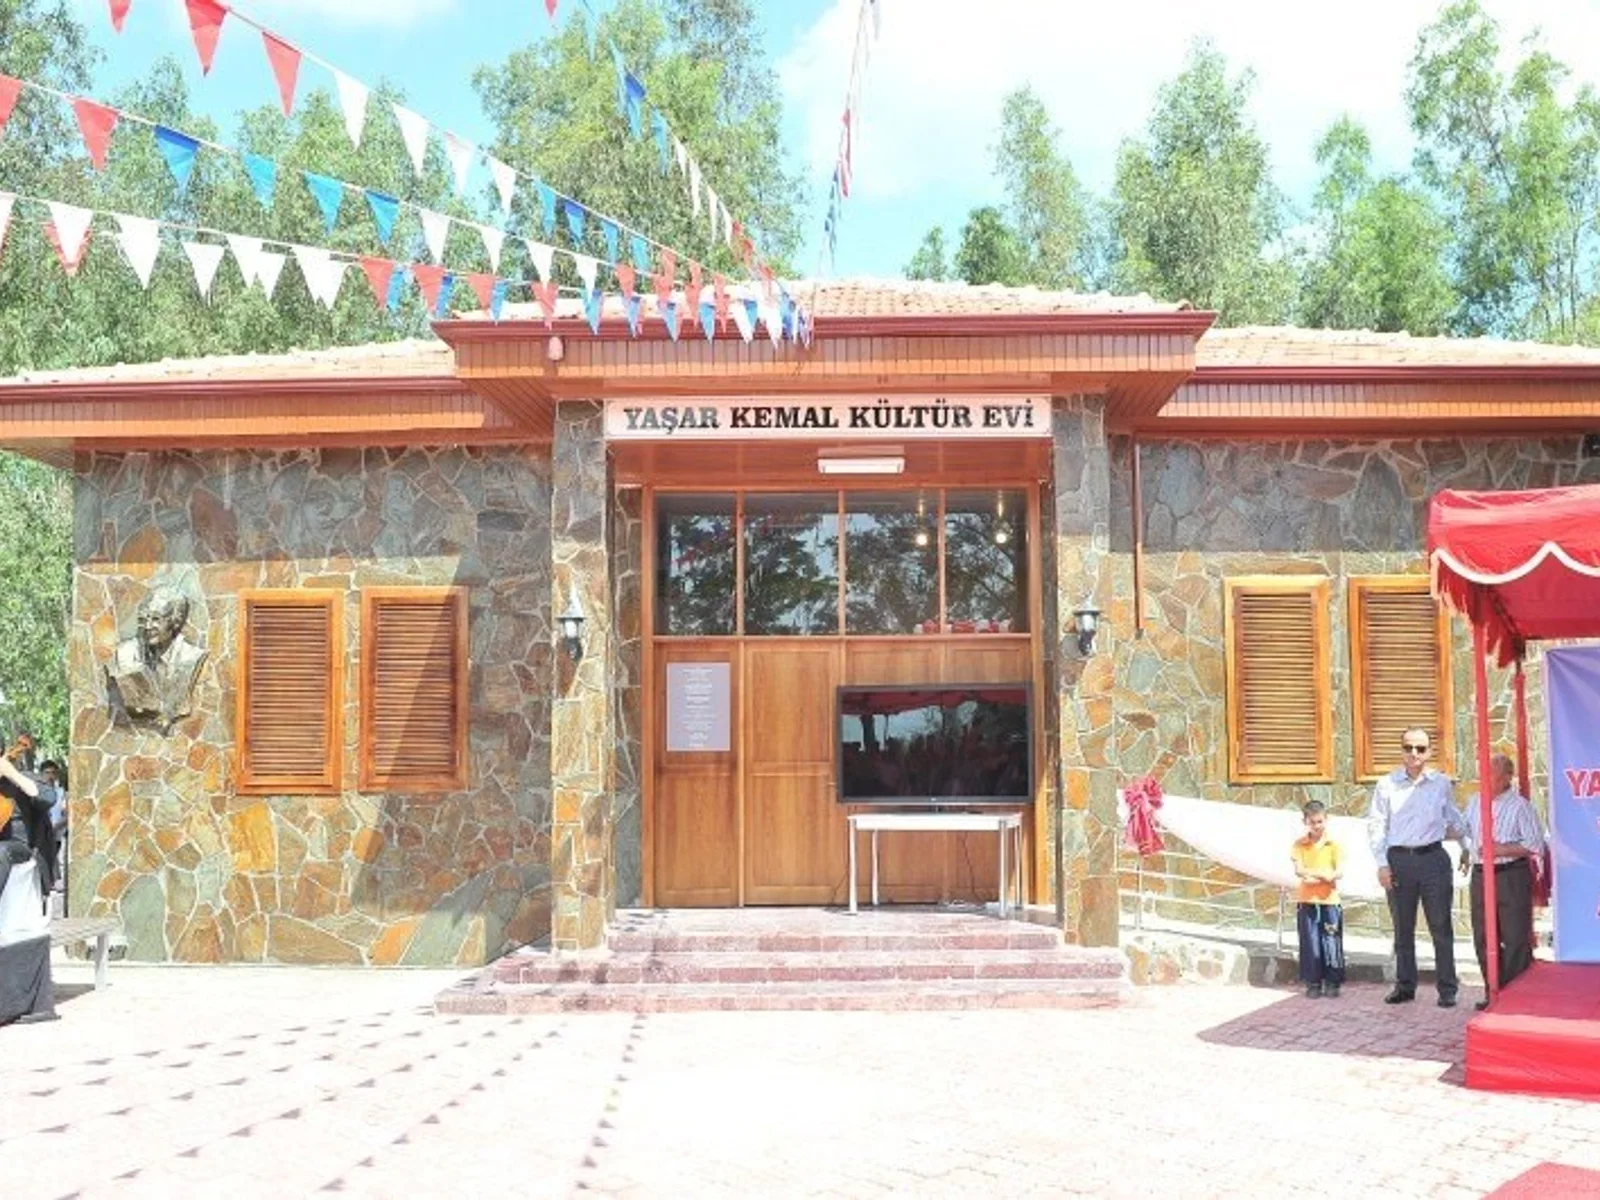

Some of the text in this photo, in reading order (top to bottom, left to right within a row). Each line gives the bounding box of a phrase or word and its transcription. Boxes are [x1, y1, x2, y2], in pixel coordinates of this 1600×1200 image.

[623, 398, 1034, 435] YAŞAR KEMAL KÜLTÜR EVİ
